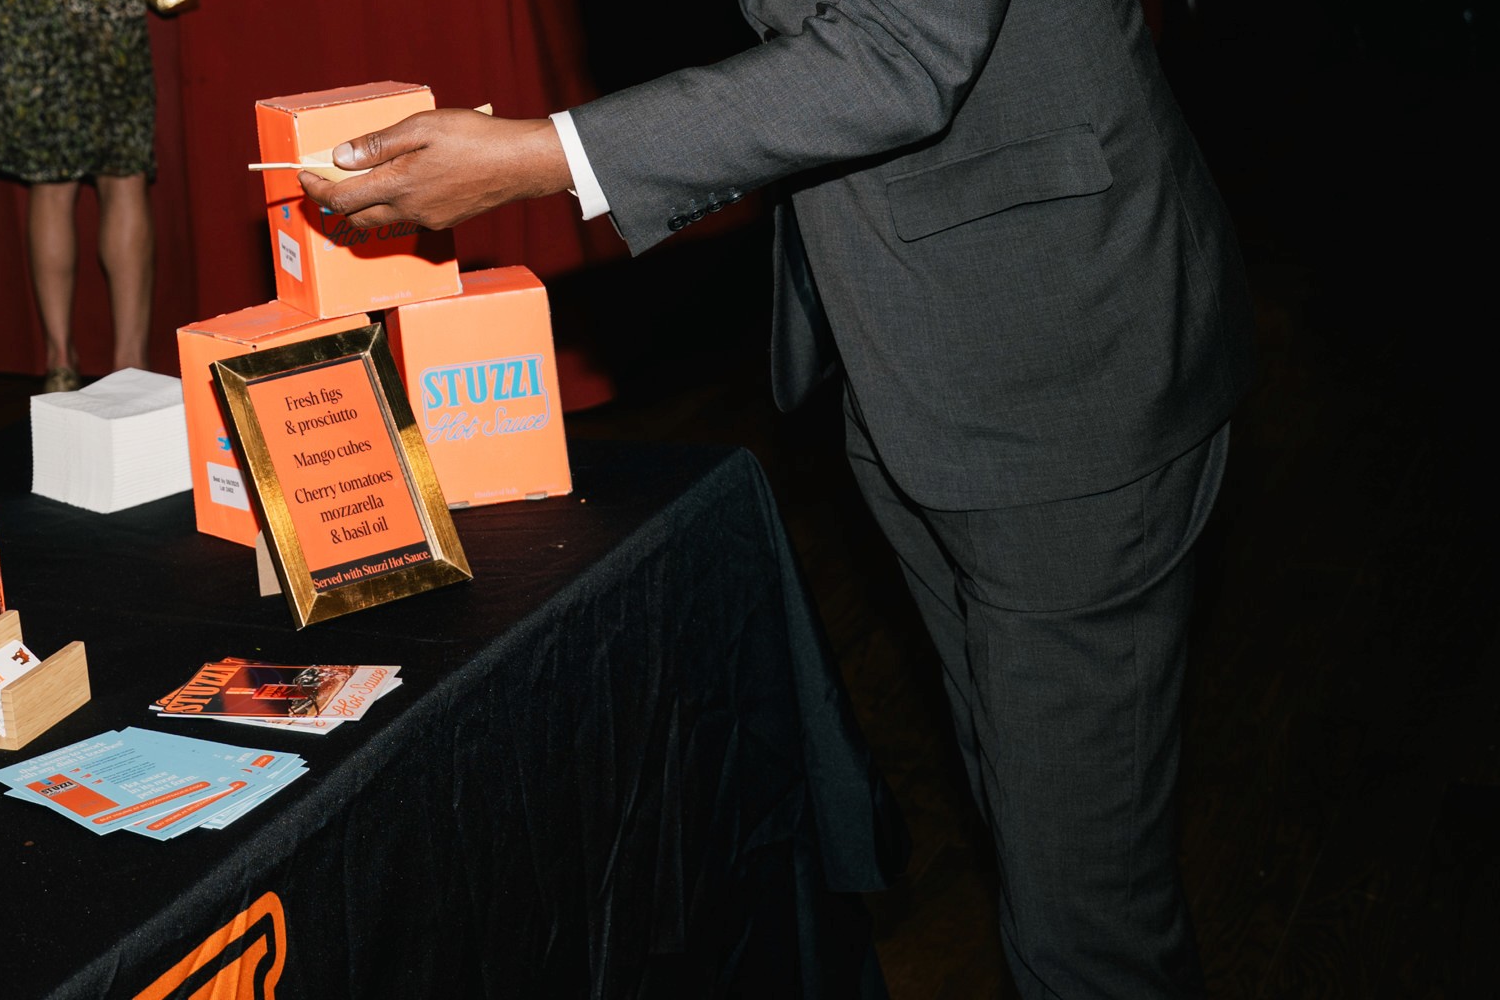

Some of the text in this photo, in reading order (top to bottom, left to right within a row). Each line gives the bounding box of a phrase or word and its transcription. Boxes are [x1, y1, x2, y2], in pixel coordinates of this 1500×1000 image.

[285, 387, 343, 411] Fresh figs
[423, 358, 542, 409] STUZZI
[285, 408, 358, 436] & prosciutto
[426, 407, 548, 443] Hot Sauce
[293, 440, 372, 469] Mango cubes
[294, 470, 393, 504] Cherry tomatoes
[320, 495, 384, 522] mozzarella
[331, 517, 388, 544] & basil oil
[312, 551, 431, 589] Served with Stuzzi Hot Sauce.
[164, 665, 241, 712] STUZZI
[332, 668, 388, 717] Hot Sauce
[41, 781, 74, 795] STUZZI
